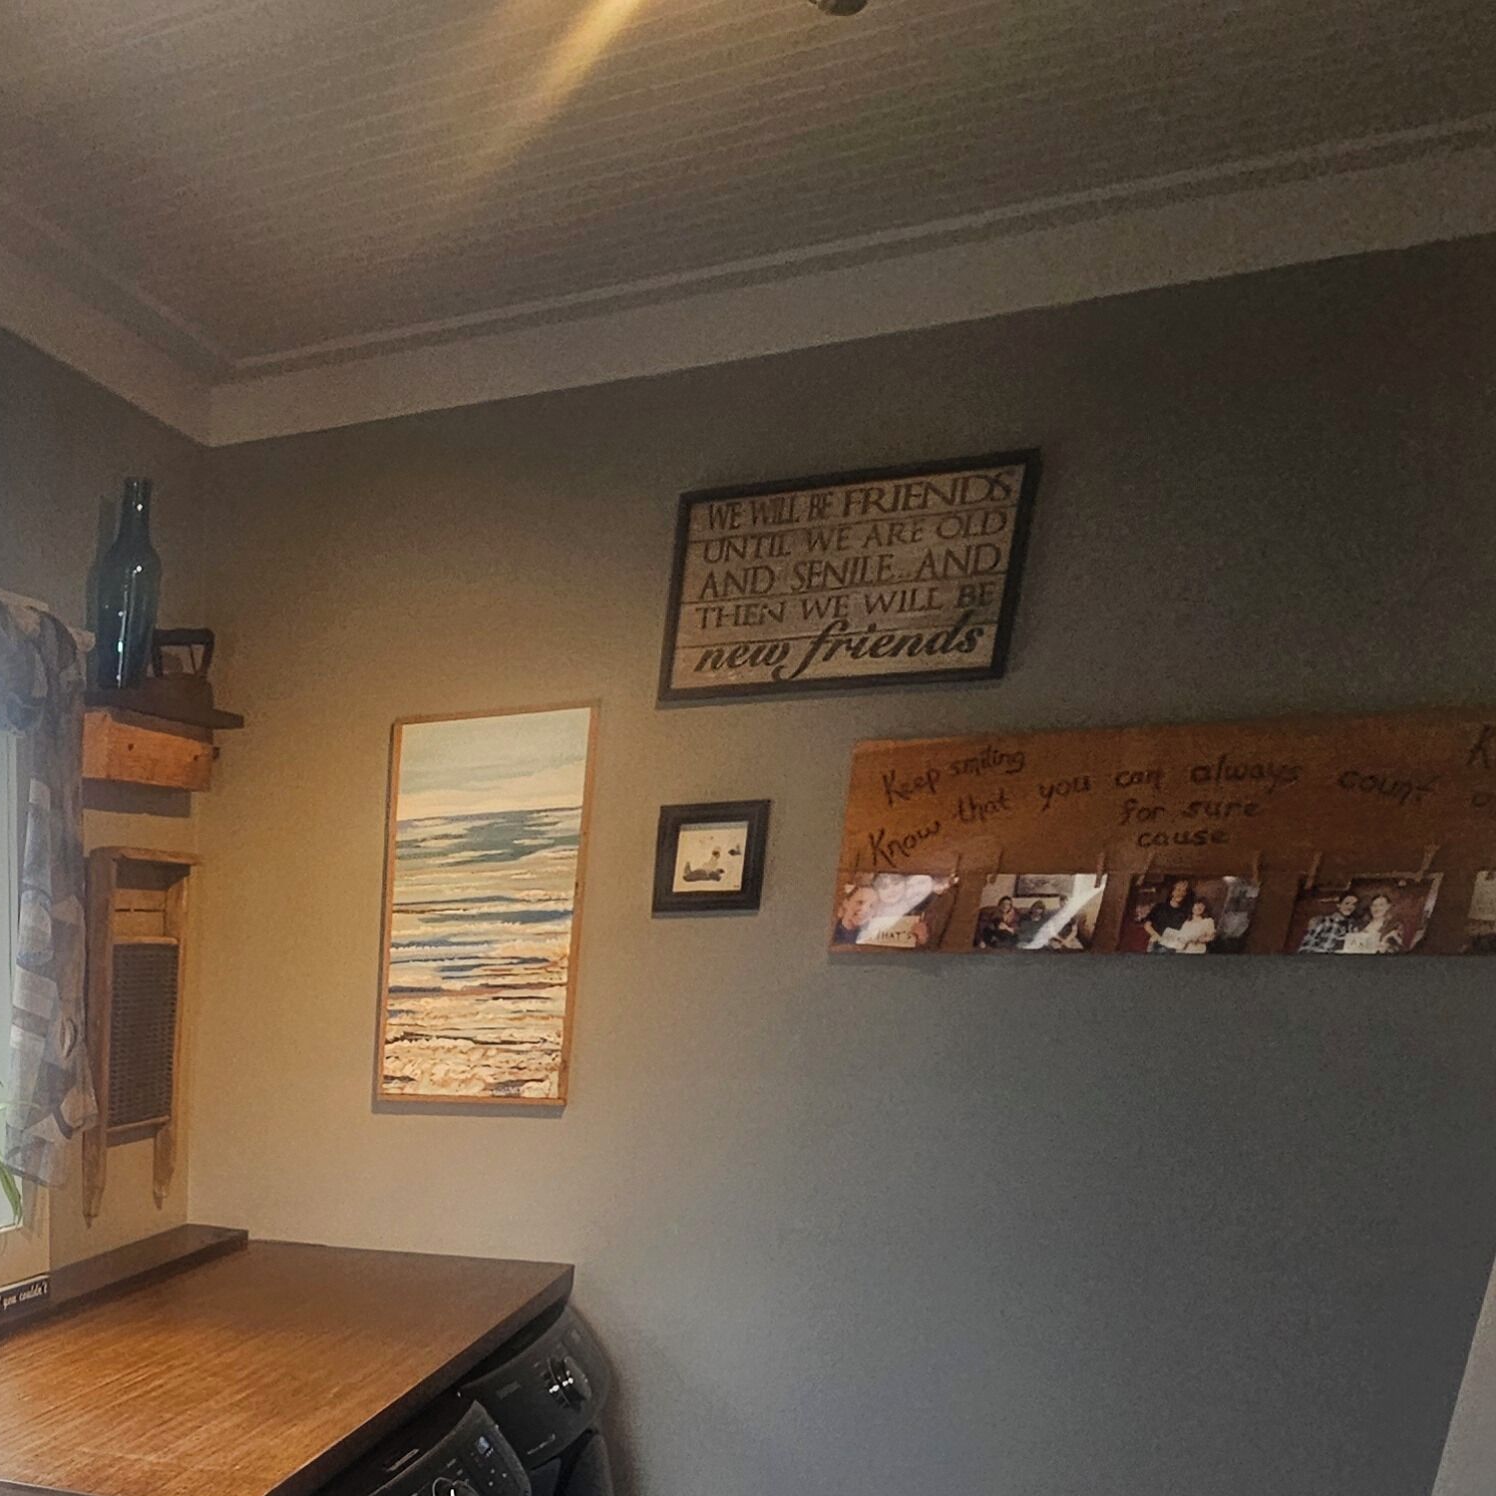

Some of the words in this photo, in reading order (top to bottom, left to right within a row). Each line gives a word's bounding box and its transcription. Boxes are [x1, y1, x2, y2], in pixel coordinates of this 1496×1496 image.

[709, 502, 743, 531] WE
[750, 496, 800, 527] WILL
[807, 490, 835, 523] BE
[842, 472, 1013, 517] FRIENDS
[703, 534, 792, 564] UNTIL
[806, 523, 851, 554] WE
[860, 517, 925, 549] ARE
[935, 509, 1008, 541] OLD
[700, 563, 777, 600] AND
[914, 541, 1003, 583] AND
[694, 600, 786, 630] THEN
[802, 594, 850, 621] WE
[862, 586, 944, 616] WILL
[954, 580, 997, 610] BE
[692, 639, 791, 673] new
[771, 611, 985, 680] friends
[867, 820, 942, 869] Know
[953, 787, 1012, 824] that
[1037, 775, 1093, 812] you
[1114, 768, 1164, 791] can
[1190, 754, 1303, 796] always
[1337, 770, 1442, 806] count
[881, 767, 941, 806] Keep
[1118, 798, 1166, 826] for
[1181, 800, 1261, 819] sure
[1137, 829, 1231, 849] cause
[3, 1294, 17, 1311] you
[19, 1281, 48, 1301] couldn't
